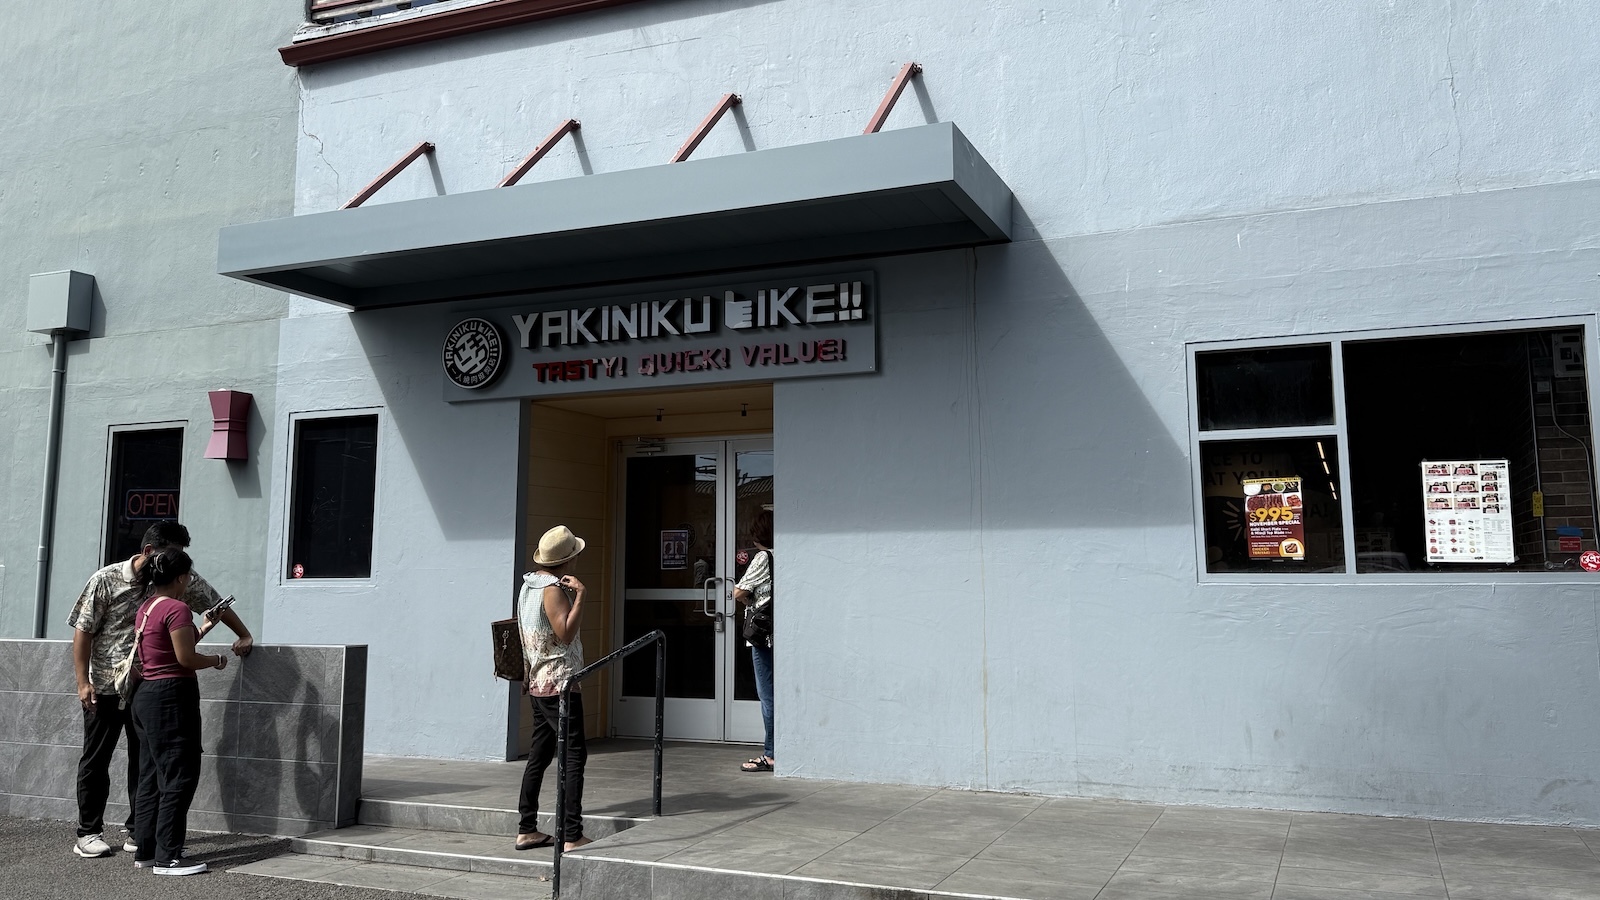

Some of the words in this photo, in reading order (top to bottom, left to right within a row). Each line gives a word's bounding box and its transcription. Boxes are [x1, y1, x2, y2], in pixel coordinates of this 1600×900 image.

[511, 294, 713, 349] YAKINIKU
[445, 321, 477, 368] YAKINIKU
[532, 356, 626, 382] TASTY!
[639, 347, 730, 376] QUICK!
[739, 339, 845, 366] VALUE!
[128, 493, 178, 515] OPEN
